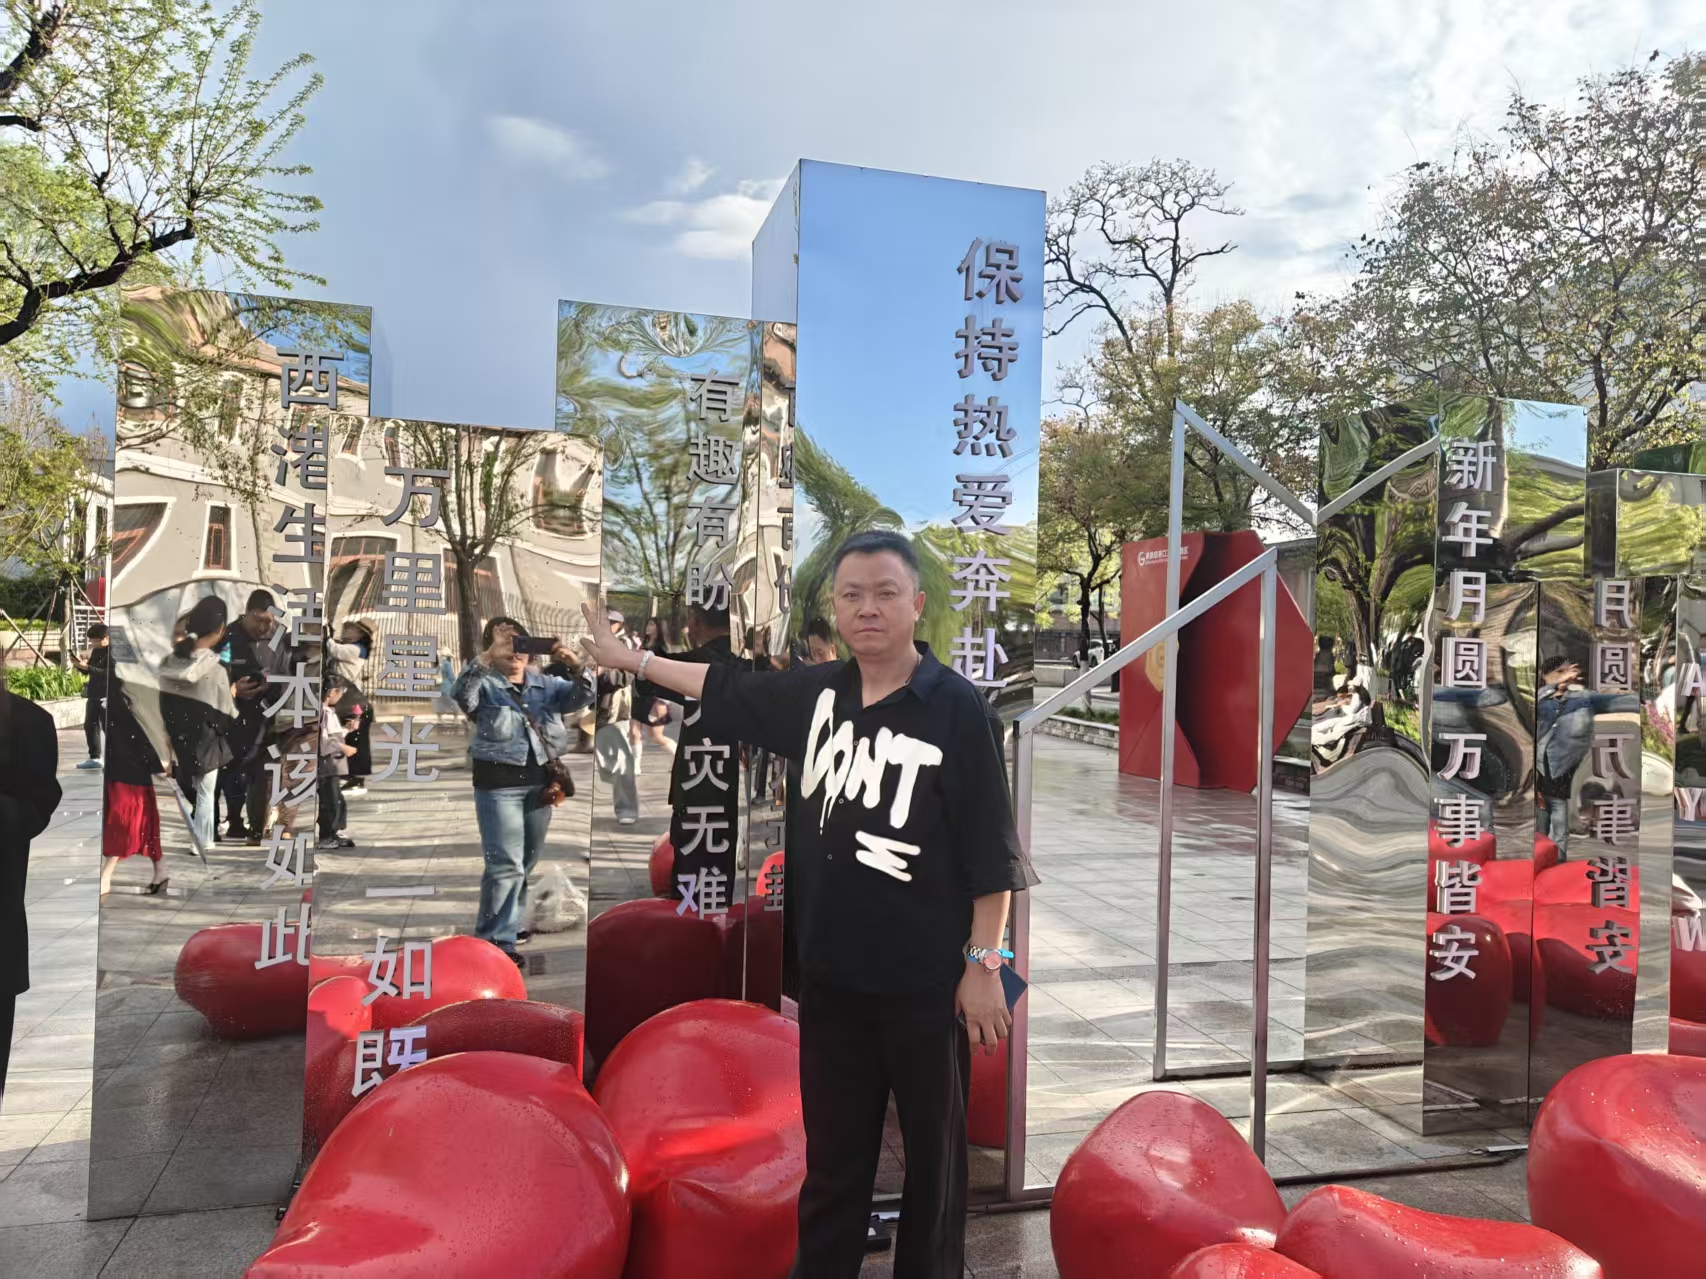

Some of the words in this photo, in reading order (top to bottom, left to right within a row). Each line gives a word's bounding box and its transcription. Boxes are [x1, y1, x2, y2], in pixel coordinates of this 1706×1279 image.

[949, 237, 1024, 687] 保持热爱奔赴
[675, 696, 731, 920] 灾无难
